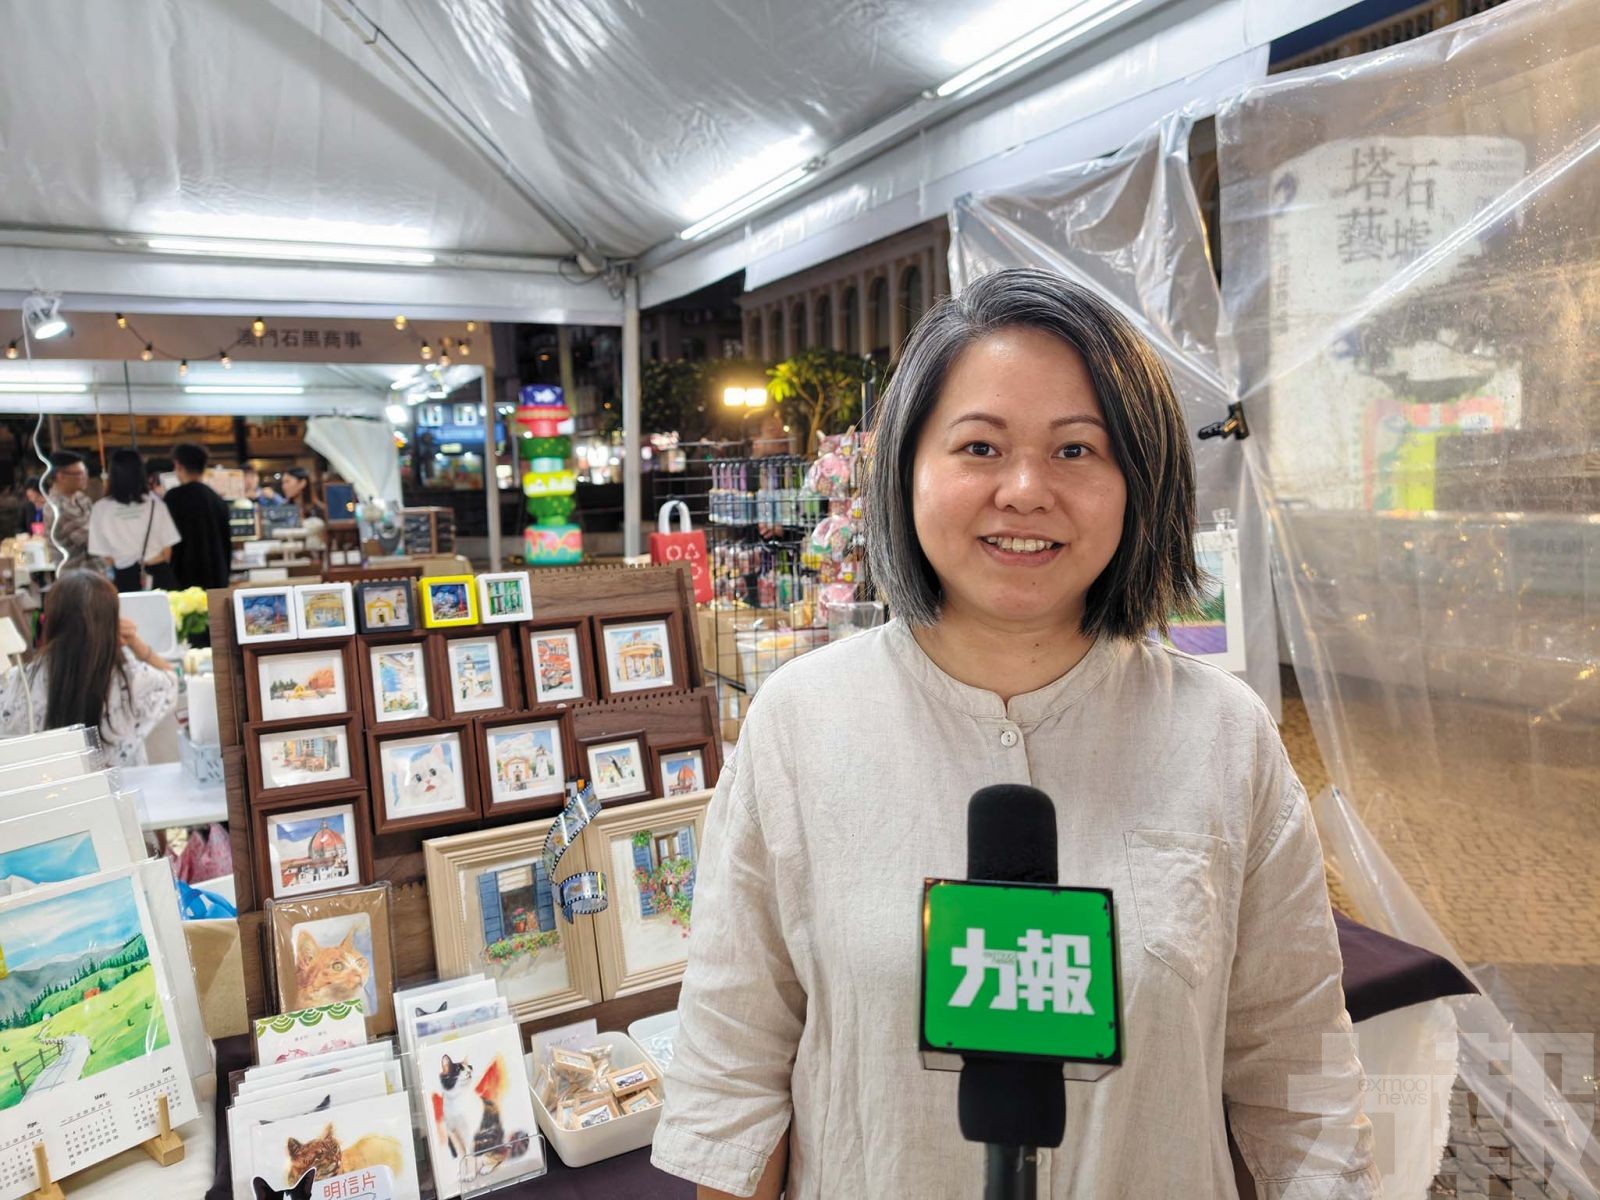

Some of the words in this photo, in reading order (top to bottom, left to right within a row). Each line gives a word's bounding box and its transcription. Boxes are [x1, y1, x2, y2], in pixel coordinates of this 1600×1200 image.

[1343, 145, 1440, 211] 塔石
[948, 928, 1095, 1015] 力報
[323, 1171, 377, 1198] 明信片
